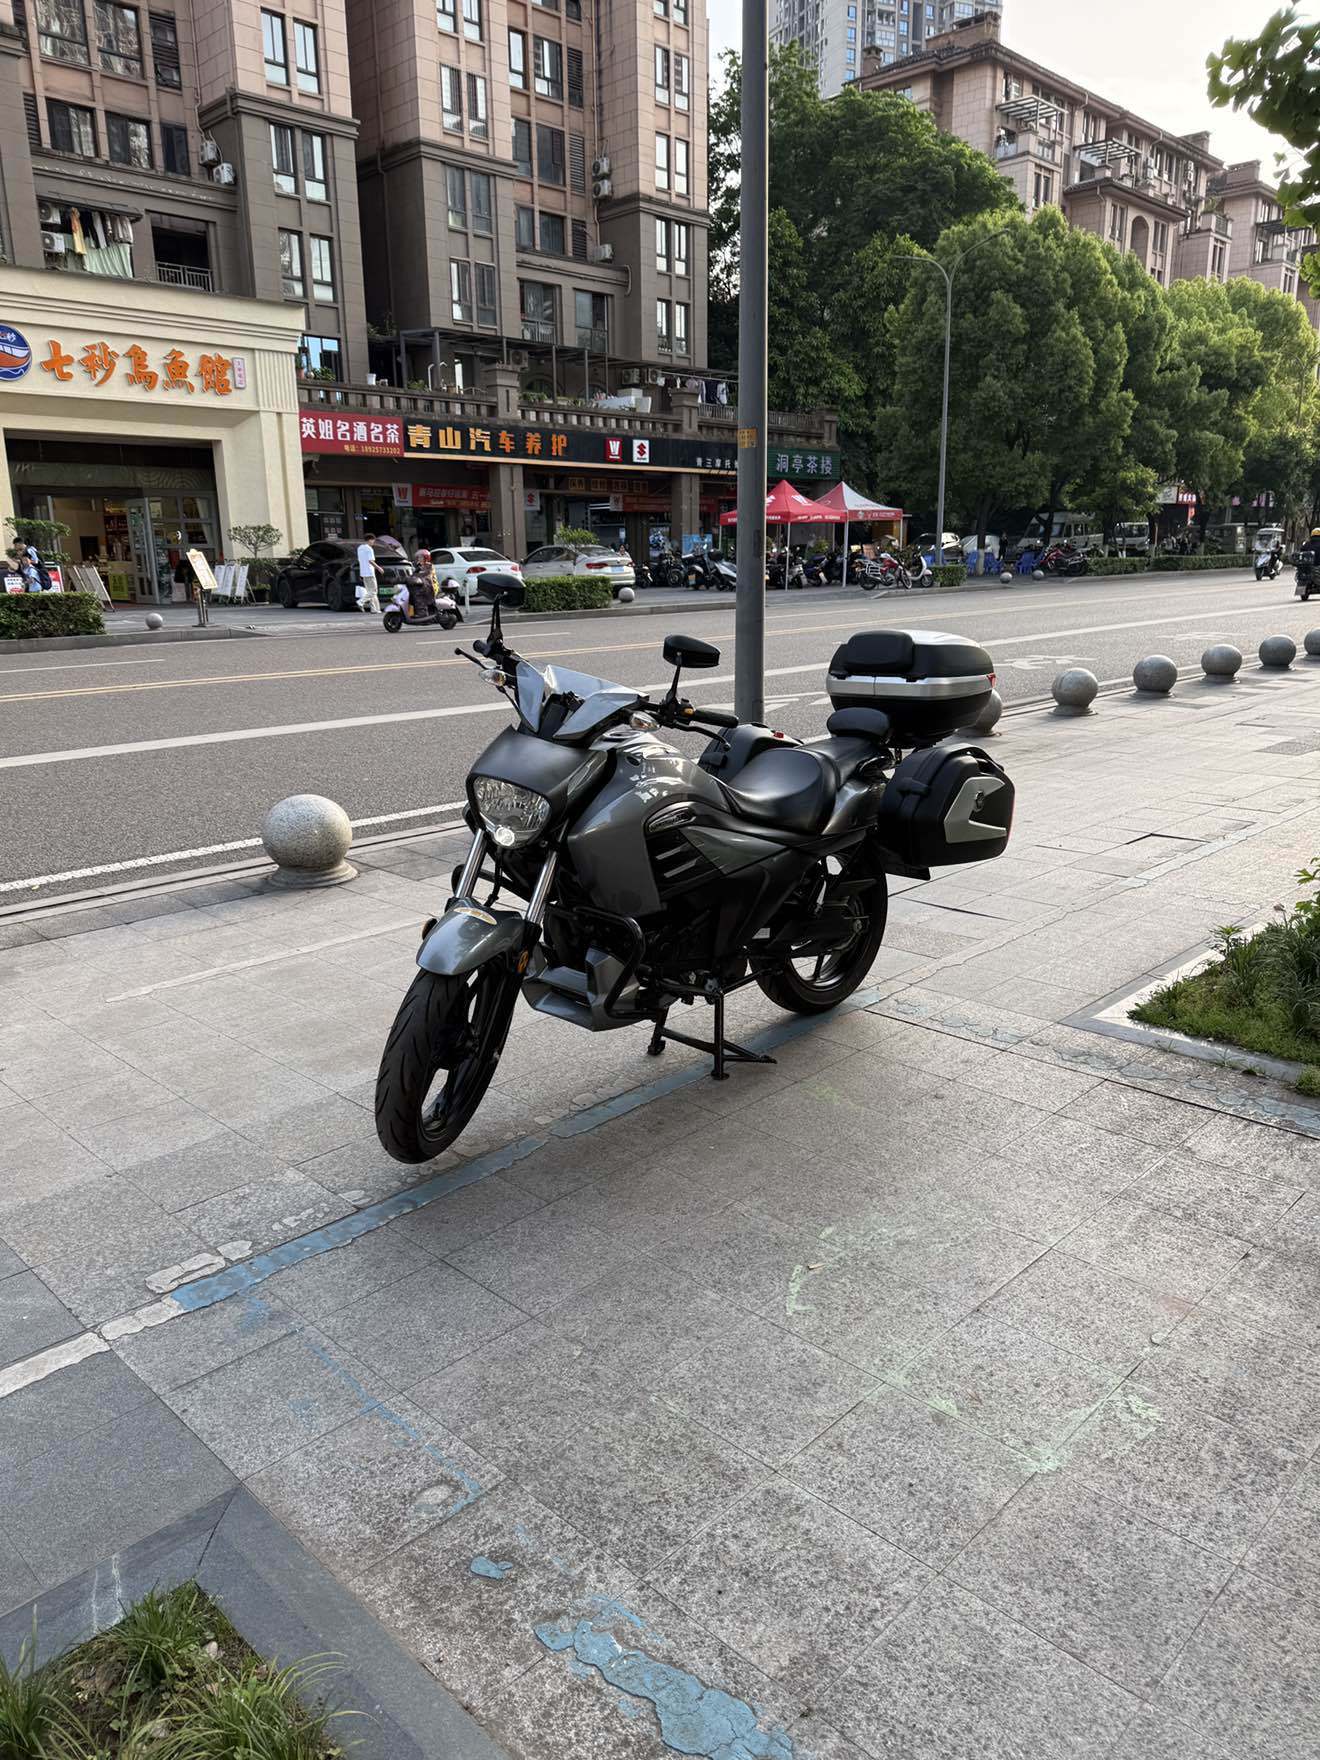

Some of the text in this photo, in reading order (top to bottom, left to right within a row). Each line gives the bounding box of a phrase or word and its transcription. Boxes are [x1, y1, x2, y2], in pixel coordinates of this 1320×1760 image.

[300, 417, 400, 444] 英姐名酒名茶
[407, 424, 568, 457] 青山汽车养护
